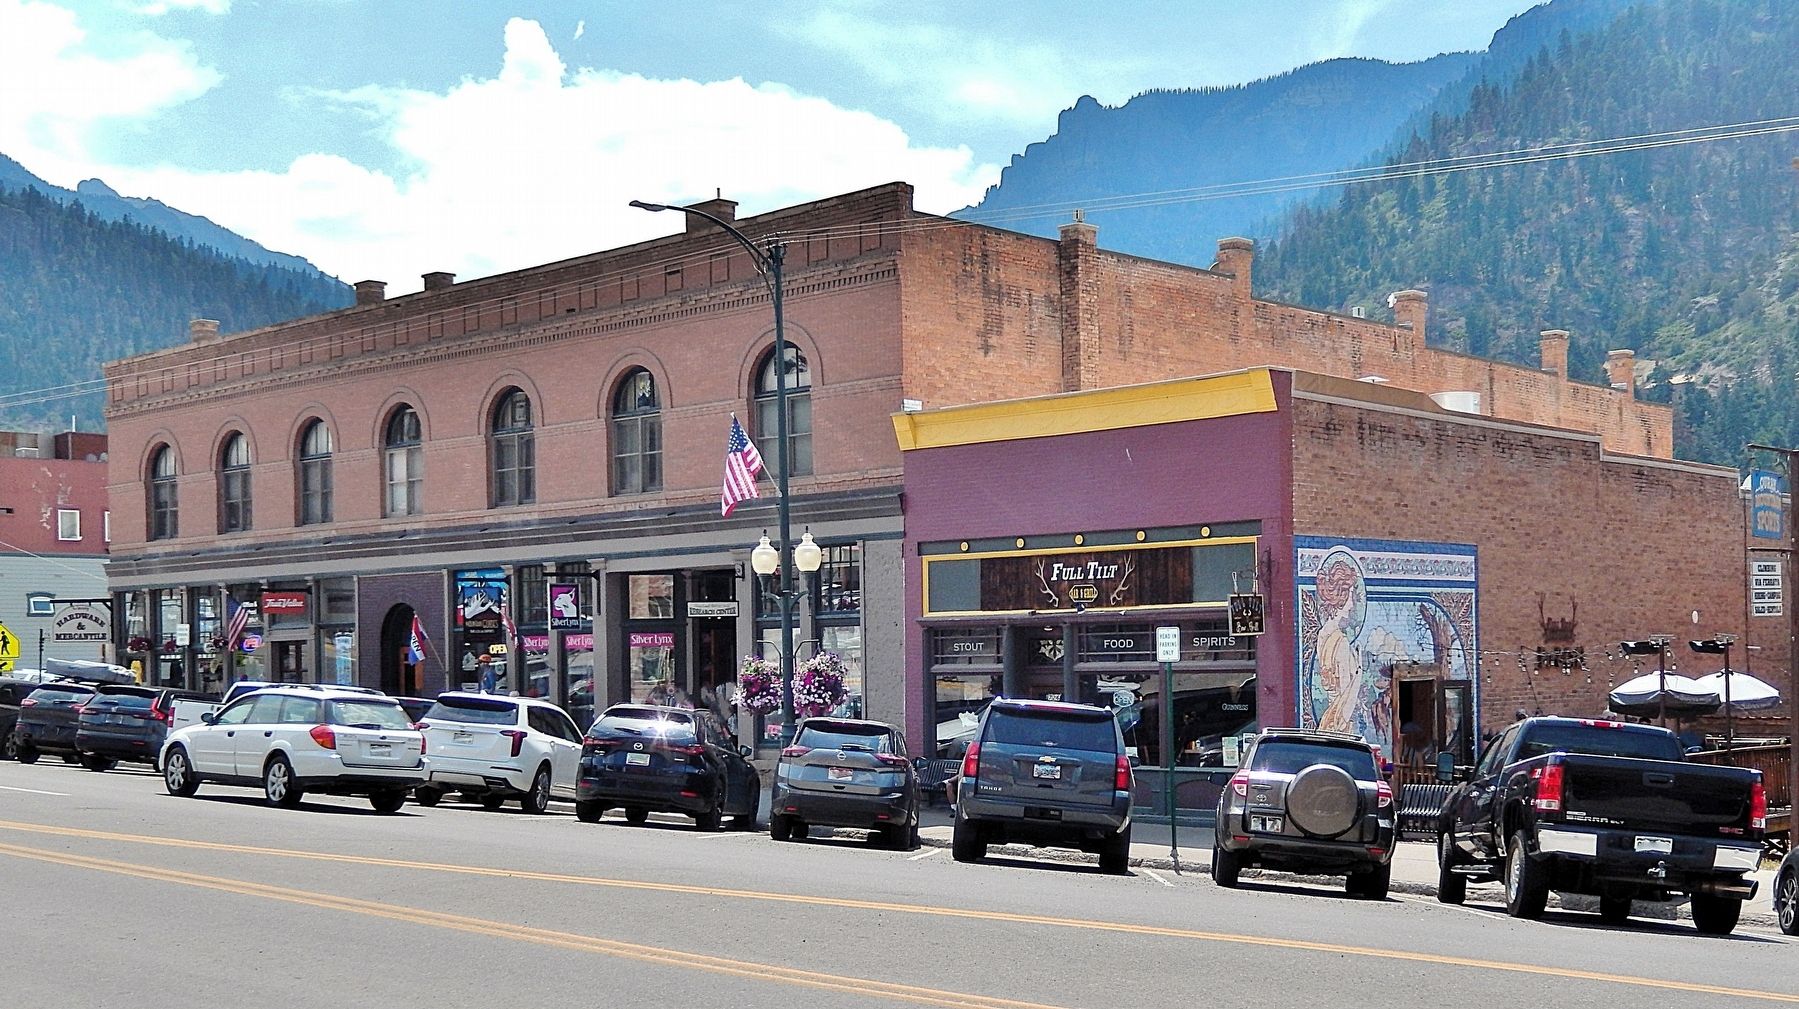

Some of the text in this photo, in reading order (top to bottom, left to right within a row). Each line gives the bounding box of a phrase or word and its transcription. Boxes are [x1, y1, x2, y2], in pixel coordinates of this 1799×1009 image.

[1051, 561, 1118, 581] FULL TILT
[56, 612, 106, 628] HARDWARE
[76, 622, 87, 631] &
[55, 632, 107, 640] MERCANTILE
[631, 634, 673, 646] Silver Lynx
[1103, 639, 1134, 649] FOOD
[1193, 636, 1236, 647] SPIRITS
[953, 642, 984, 652] STOUT
[1566, 814, 1609, 823] SIERRA
